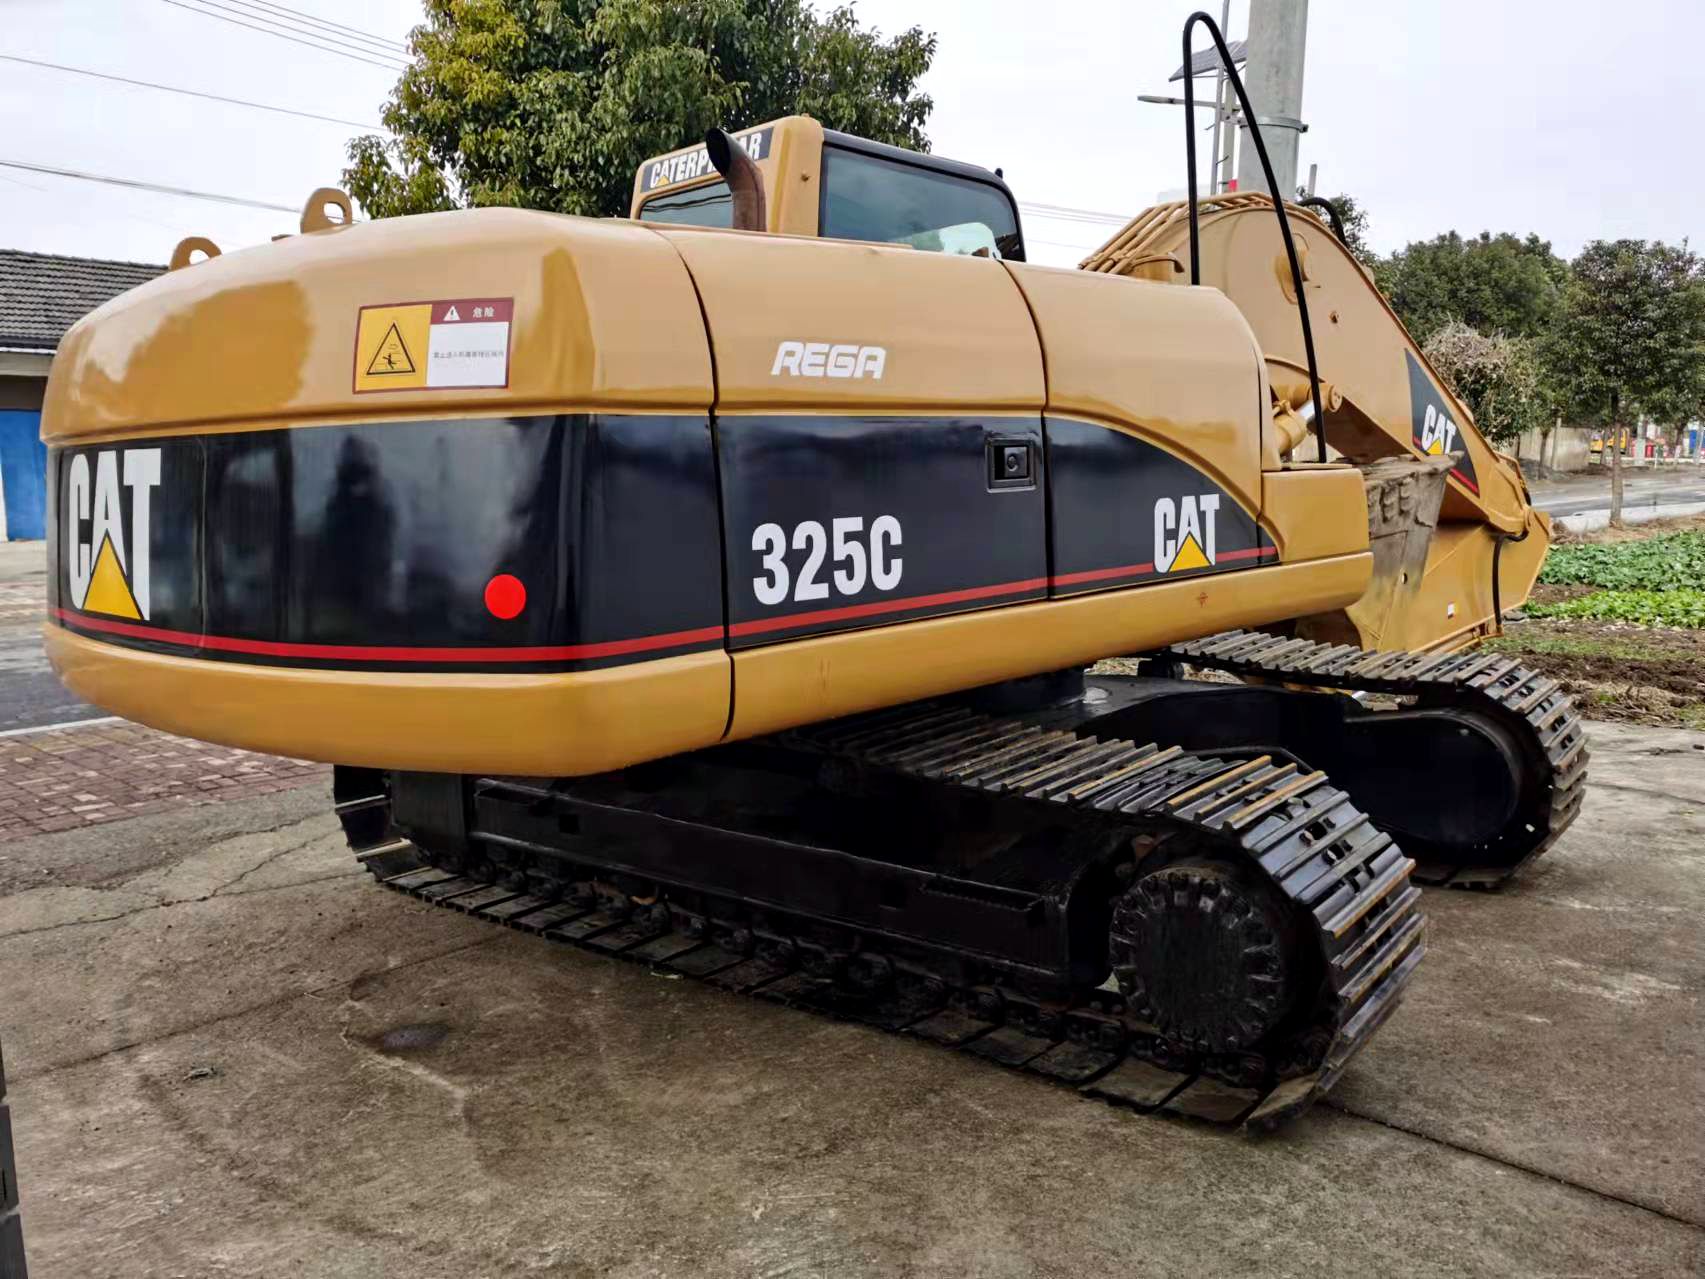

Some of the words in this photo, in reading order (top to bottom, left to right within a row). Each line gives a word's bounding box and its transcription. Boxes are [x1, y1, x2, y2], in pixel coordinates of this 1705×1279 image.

[770, 341, 887, 379] REGA
[1421, 404, 1456, 455] CAT
[69, 448, 161, 621] CAT
[751, 515, 903, 605] 325C
[1154, 493, 1220, 573] CAT
